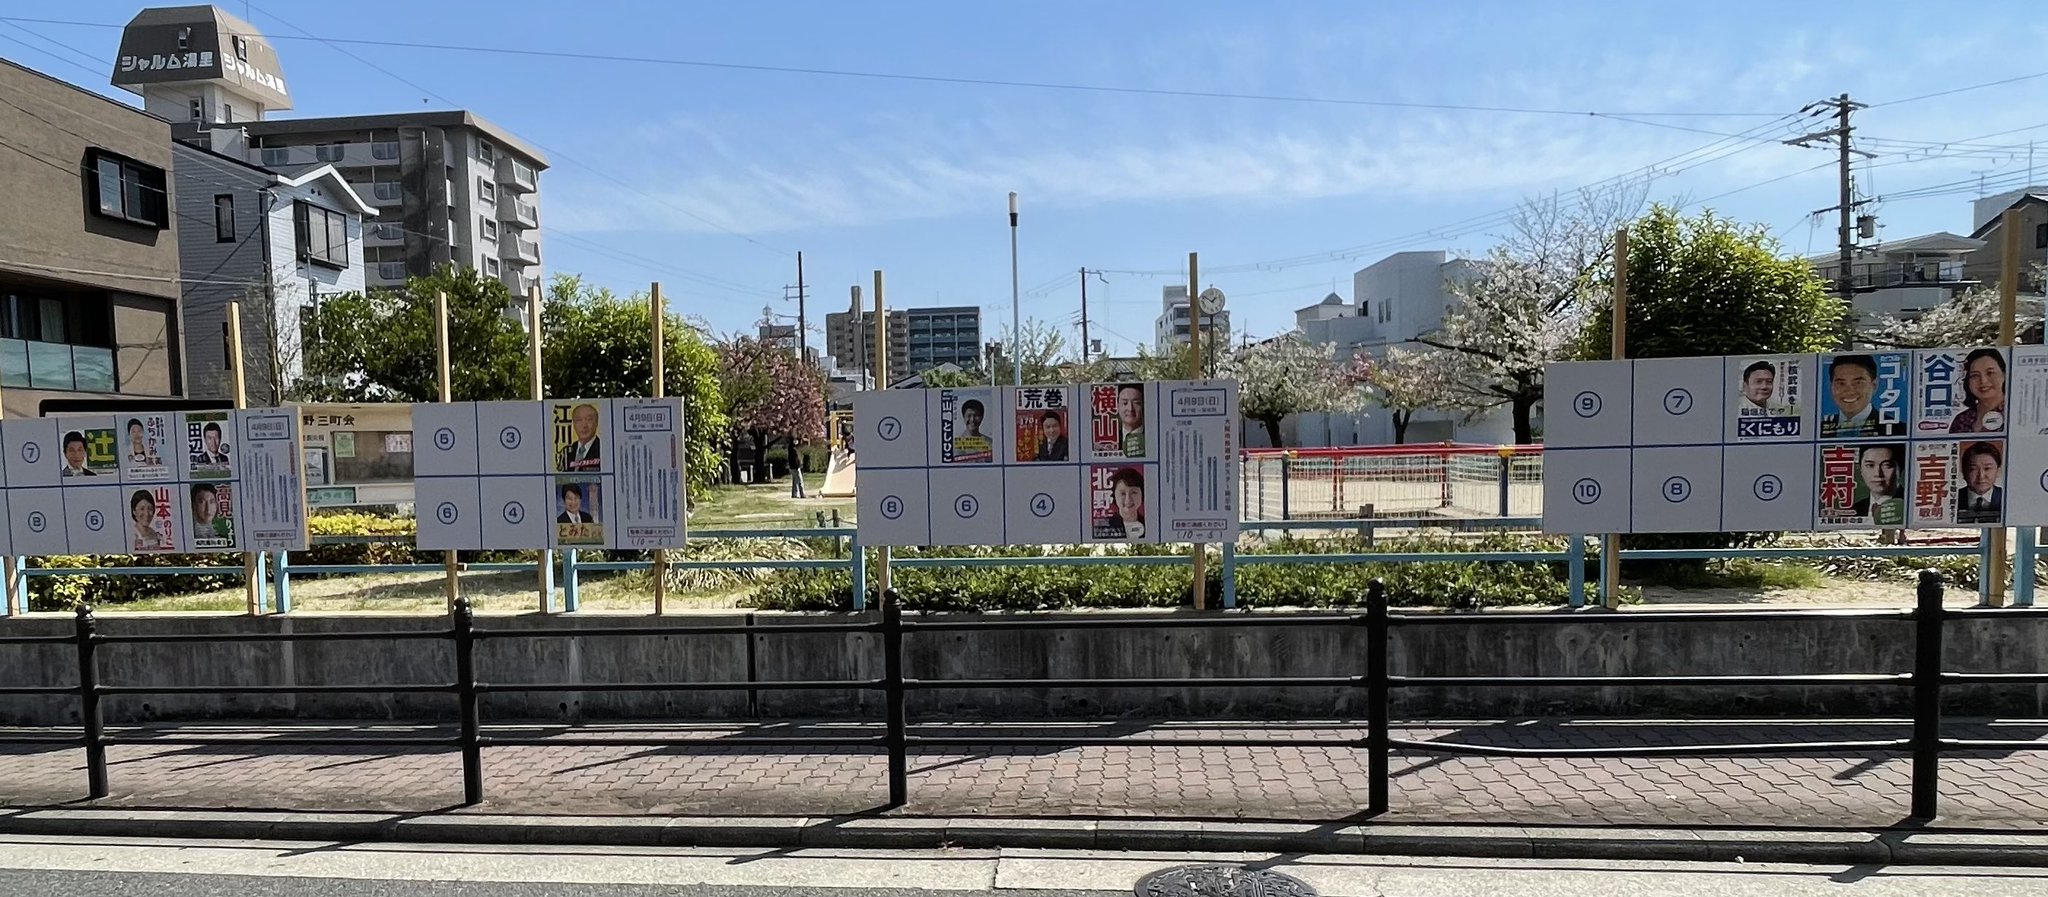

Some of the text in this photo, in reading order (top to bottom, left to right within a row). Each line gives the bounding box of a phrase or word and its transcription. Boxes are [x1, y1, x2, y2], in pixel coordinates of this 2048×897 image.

[121, 51, 214, 72] シャルム湯里
[1924, 354, 1955, 407] 谷口
[1023, 388, 1063, 409] 荒巻
[1092, 385, 1119, 443] 横山
[1177, 396, 1220, 406] 4月9日(日)
[1879, 362, 1901, 435] コータロー
[188, 422, 203, 454] 田辺
[552, 404, 573, 445] 江川
[1746, 422, 1799, 435] くにもり
[86, 431, 115, 461] 辻
[1092, 467, 1114, 510] 北野
[1821, 446, 1857, 507] 吉村
[1916, 454, 1949, 507] 吉野
[155, 487, 171, 520] 山本
[214, 484, 233, 517] 高見
